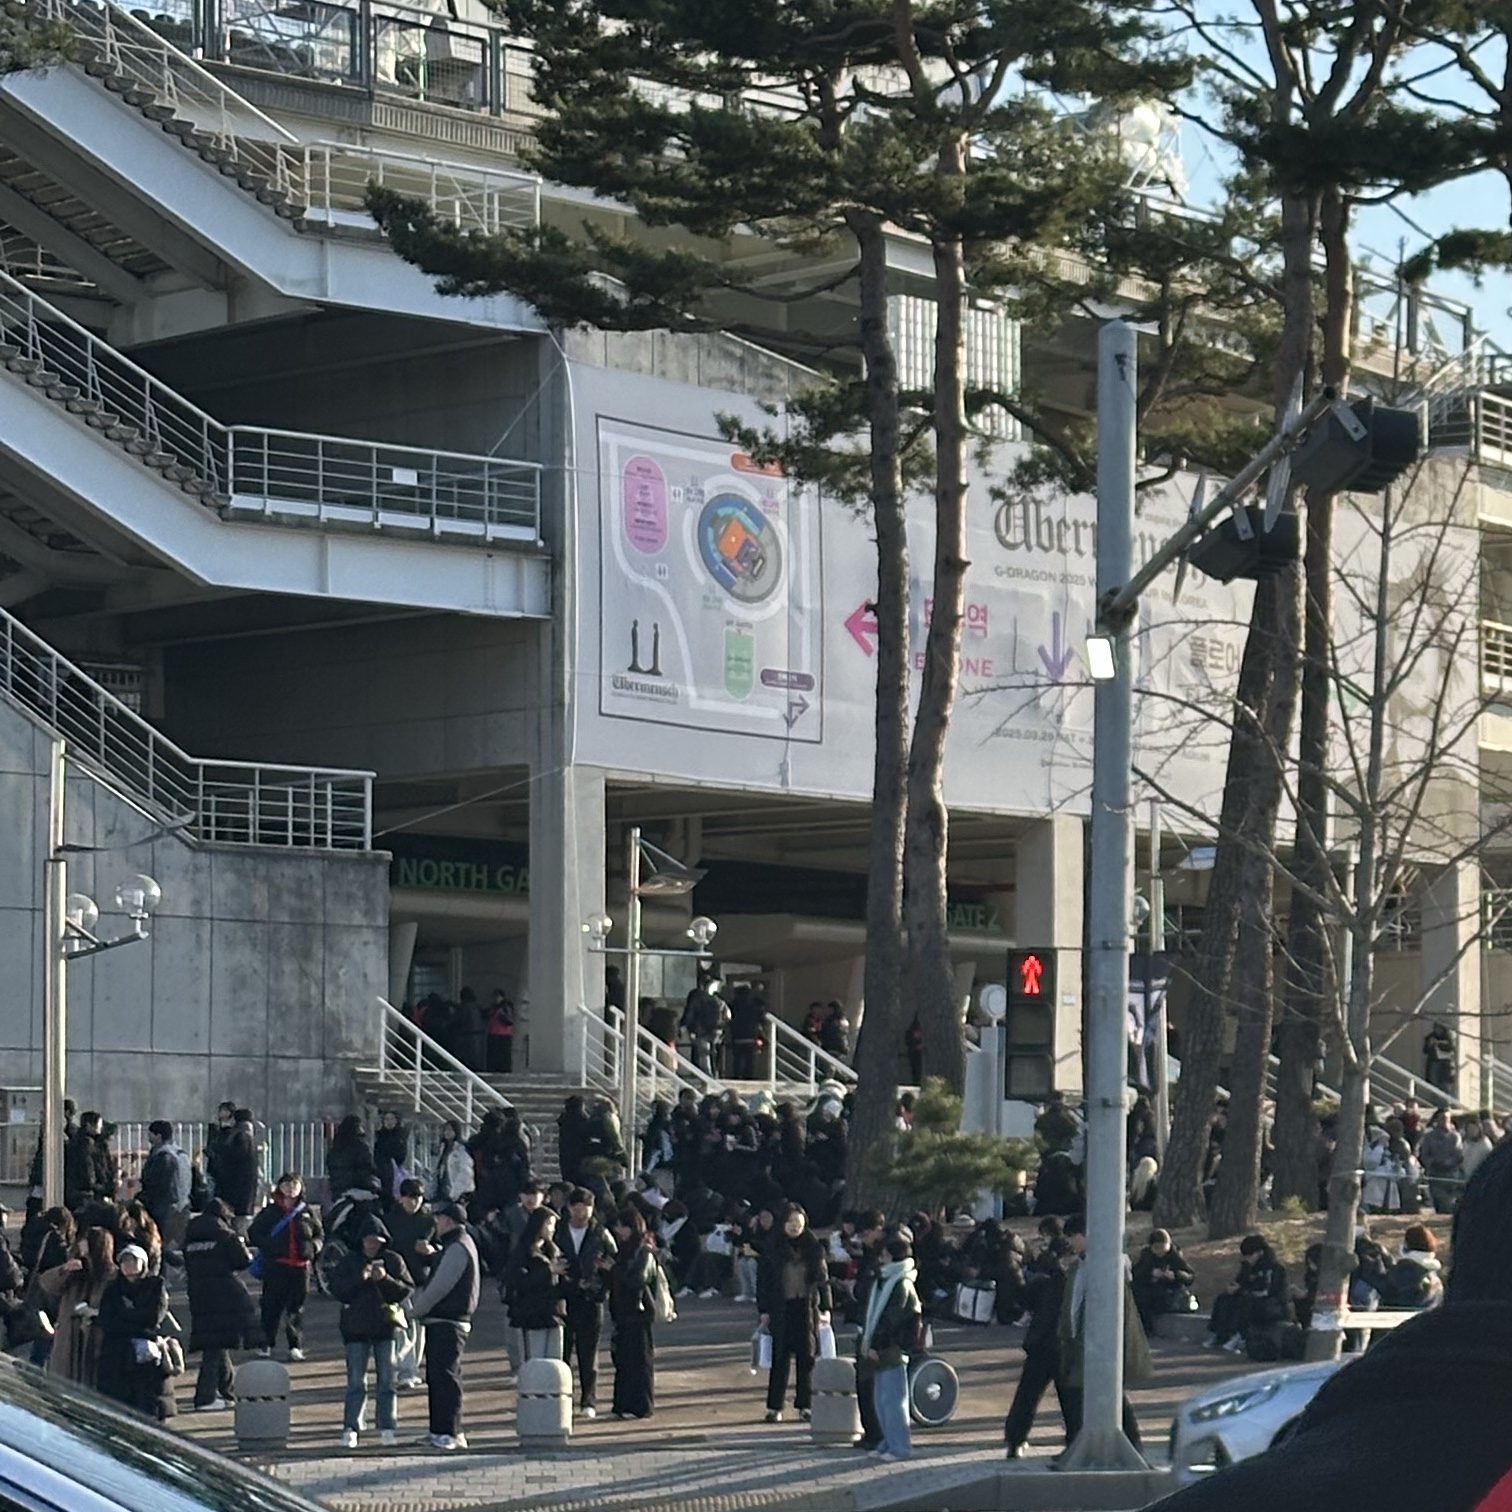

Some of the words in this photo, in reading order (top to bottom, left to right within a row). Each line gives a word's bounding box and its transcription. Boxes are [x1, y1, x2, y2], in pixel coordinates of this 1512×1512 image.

[993, 564, 1057, 583] G-DRAGON
[1059, 572, 1086, 586] 2025
[399, 858, 488, 889] NORTH
[497, 863, 529, 893] GA
